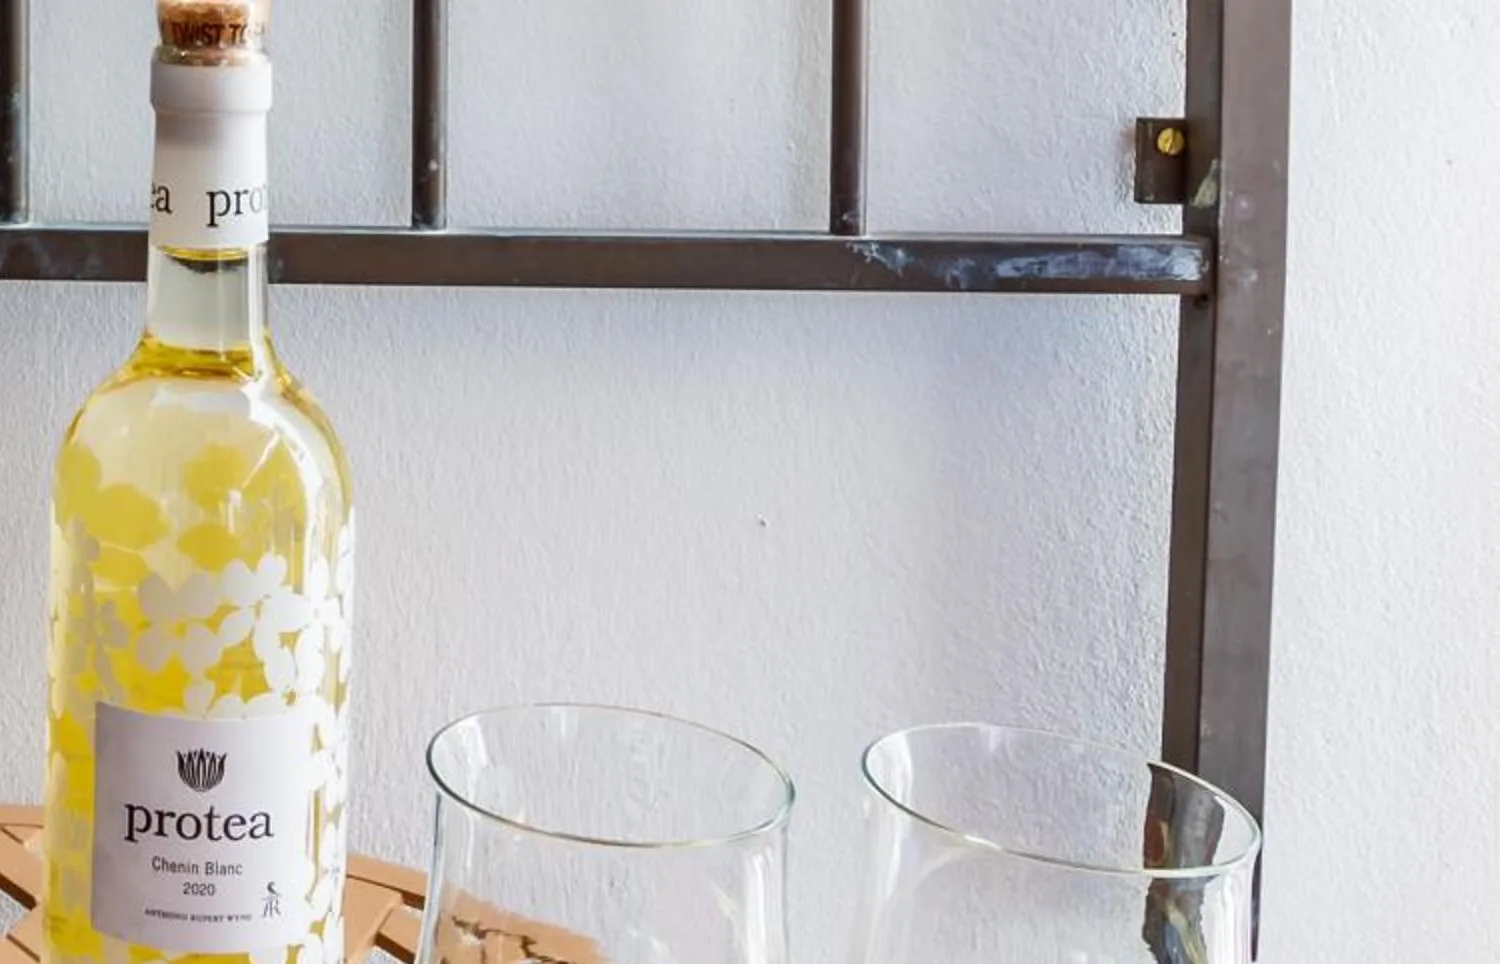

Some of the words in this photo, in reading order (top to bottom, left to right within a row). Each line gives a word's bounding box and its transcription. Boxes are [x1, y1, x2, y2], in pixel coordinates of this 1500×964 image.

[171, 21, 225, 47] TWIST
[124, 803, 274, 844] protea
[151, 855, 199, 876] Chenin
[204, 861, 243, 876] Blanc
[182, 881, 217, 897] 2020
